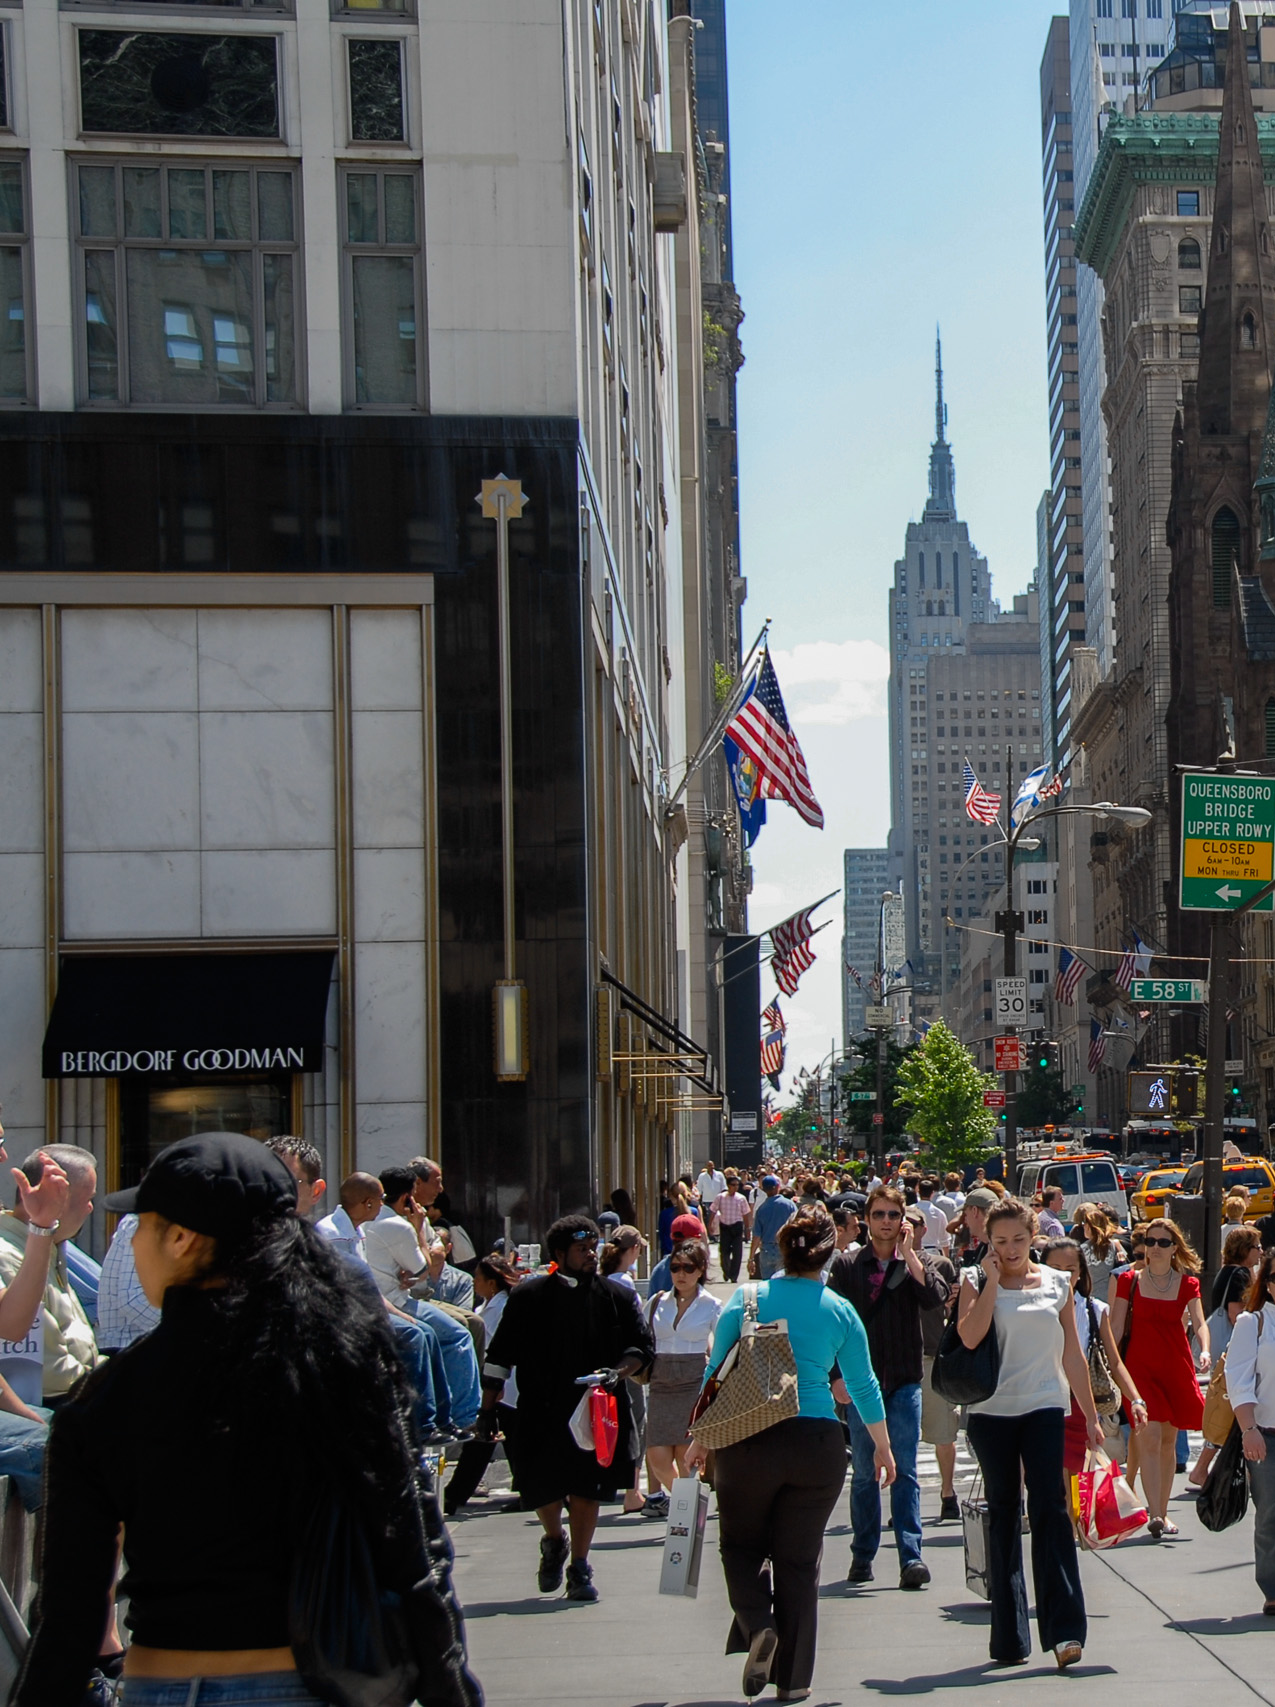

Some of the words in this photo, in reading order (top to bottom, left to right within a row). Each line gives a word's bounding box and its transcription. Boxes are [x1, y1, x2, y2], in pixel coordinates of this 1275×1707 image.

[1189, 783, 1271, 800] QUEENSBORO
[1205, 802, 1255, 819] BRIDGE
[1187, 821, 1230, 836] UPPER
[1236, 823, 1272, 838] RDWY
[1202, 842, 1255, 855] CLOSED
[1197, 866, 1218, 876] MON
[1222, 869, 1240, 877] THRU
[1243, 868, 1259, 877] FRI
[1134, 982, 1144, 999] E
[1152, 982, 1176, 999] 58
[1178, 983, 1190, 992] ST
[999, 998, 1024, 1012] 30
[62, 1050, 177, 1072] BERGDORF
[183, 1047, 304, 1071] GOODMAN
